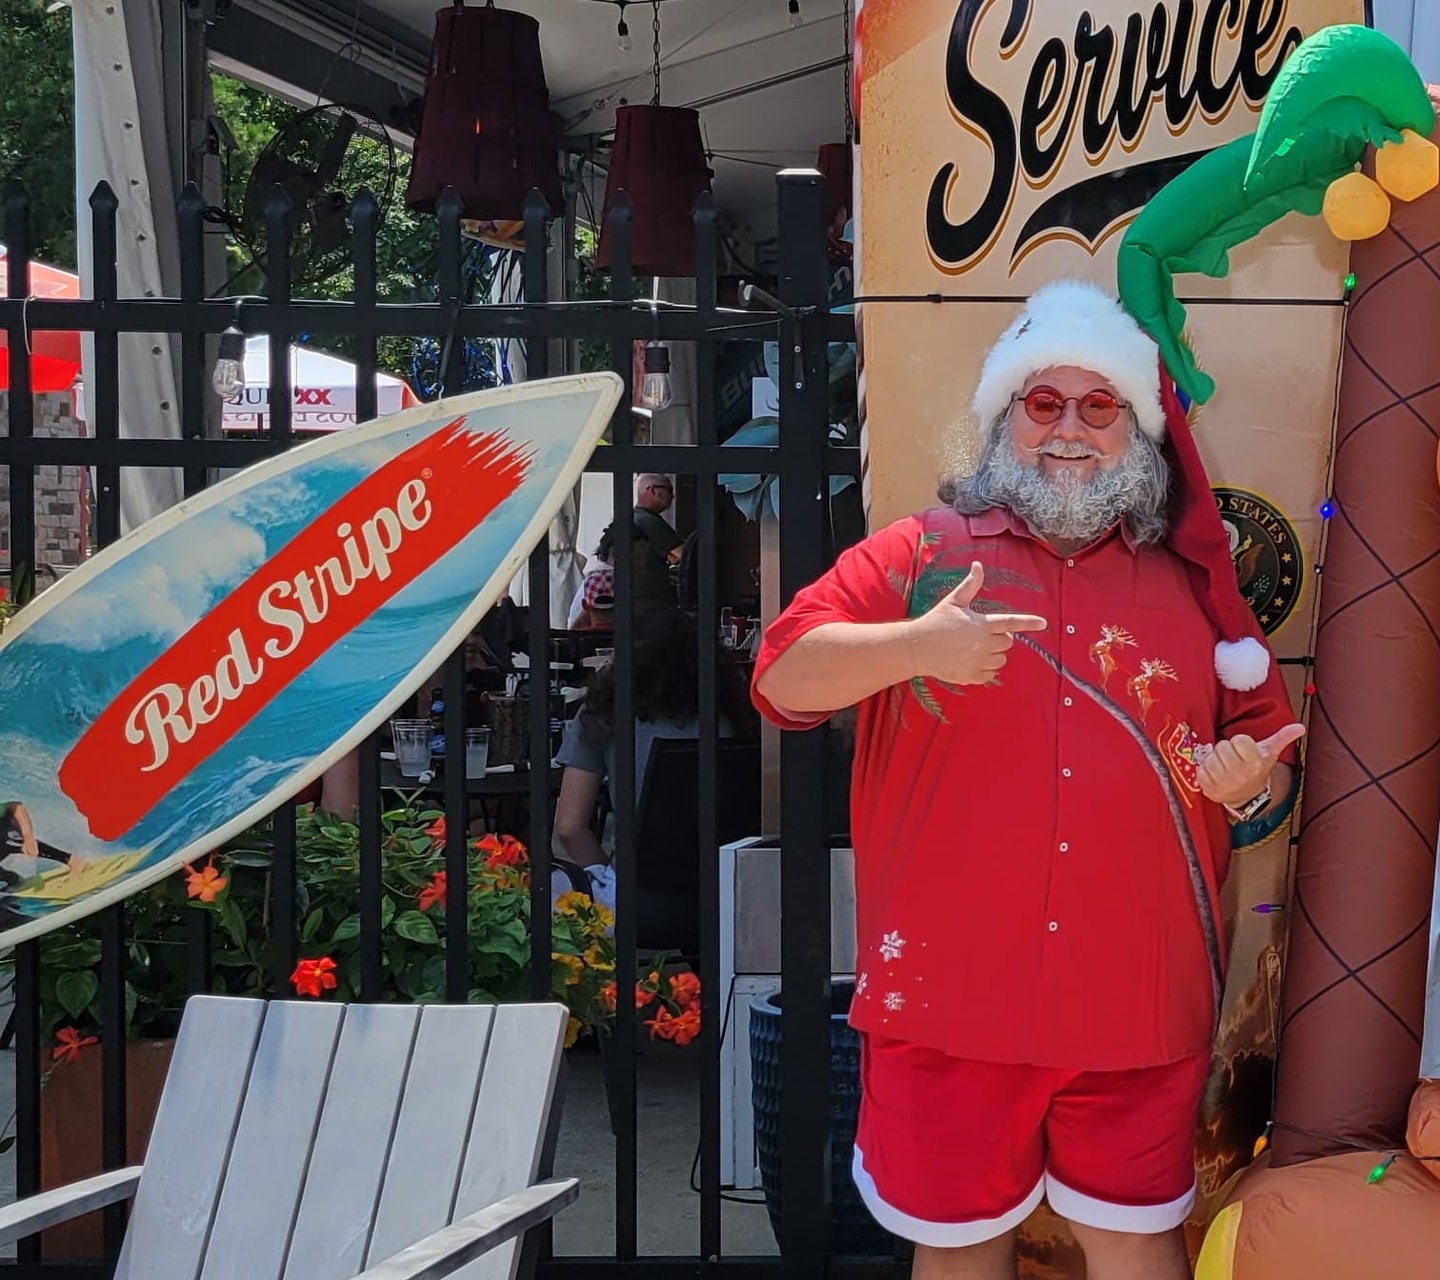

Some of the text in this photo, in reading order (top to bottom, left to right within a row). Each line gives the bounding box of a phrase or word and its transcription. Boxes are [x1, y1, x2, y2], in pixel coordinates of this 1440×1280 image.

[1228, 497, 1287, 544] STATES
[125, 478, 433, 772] Red Stripe
